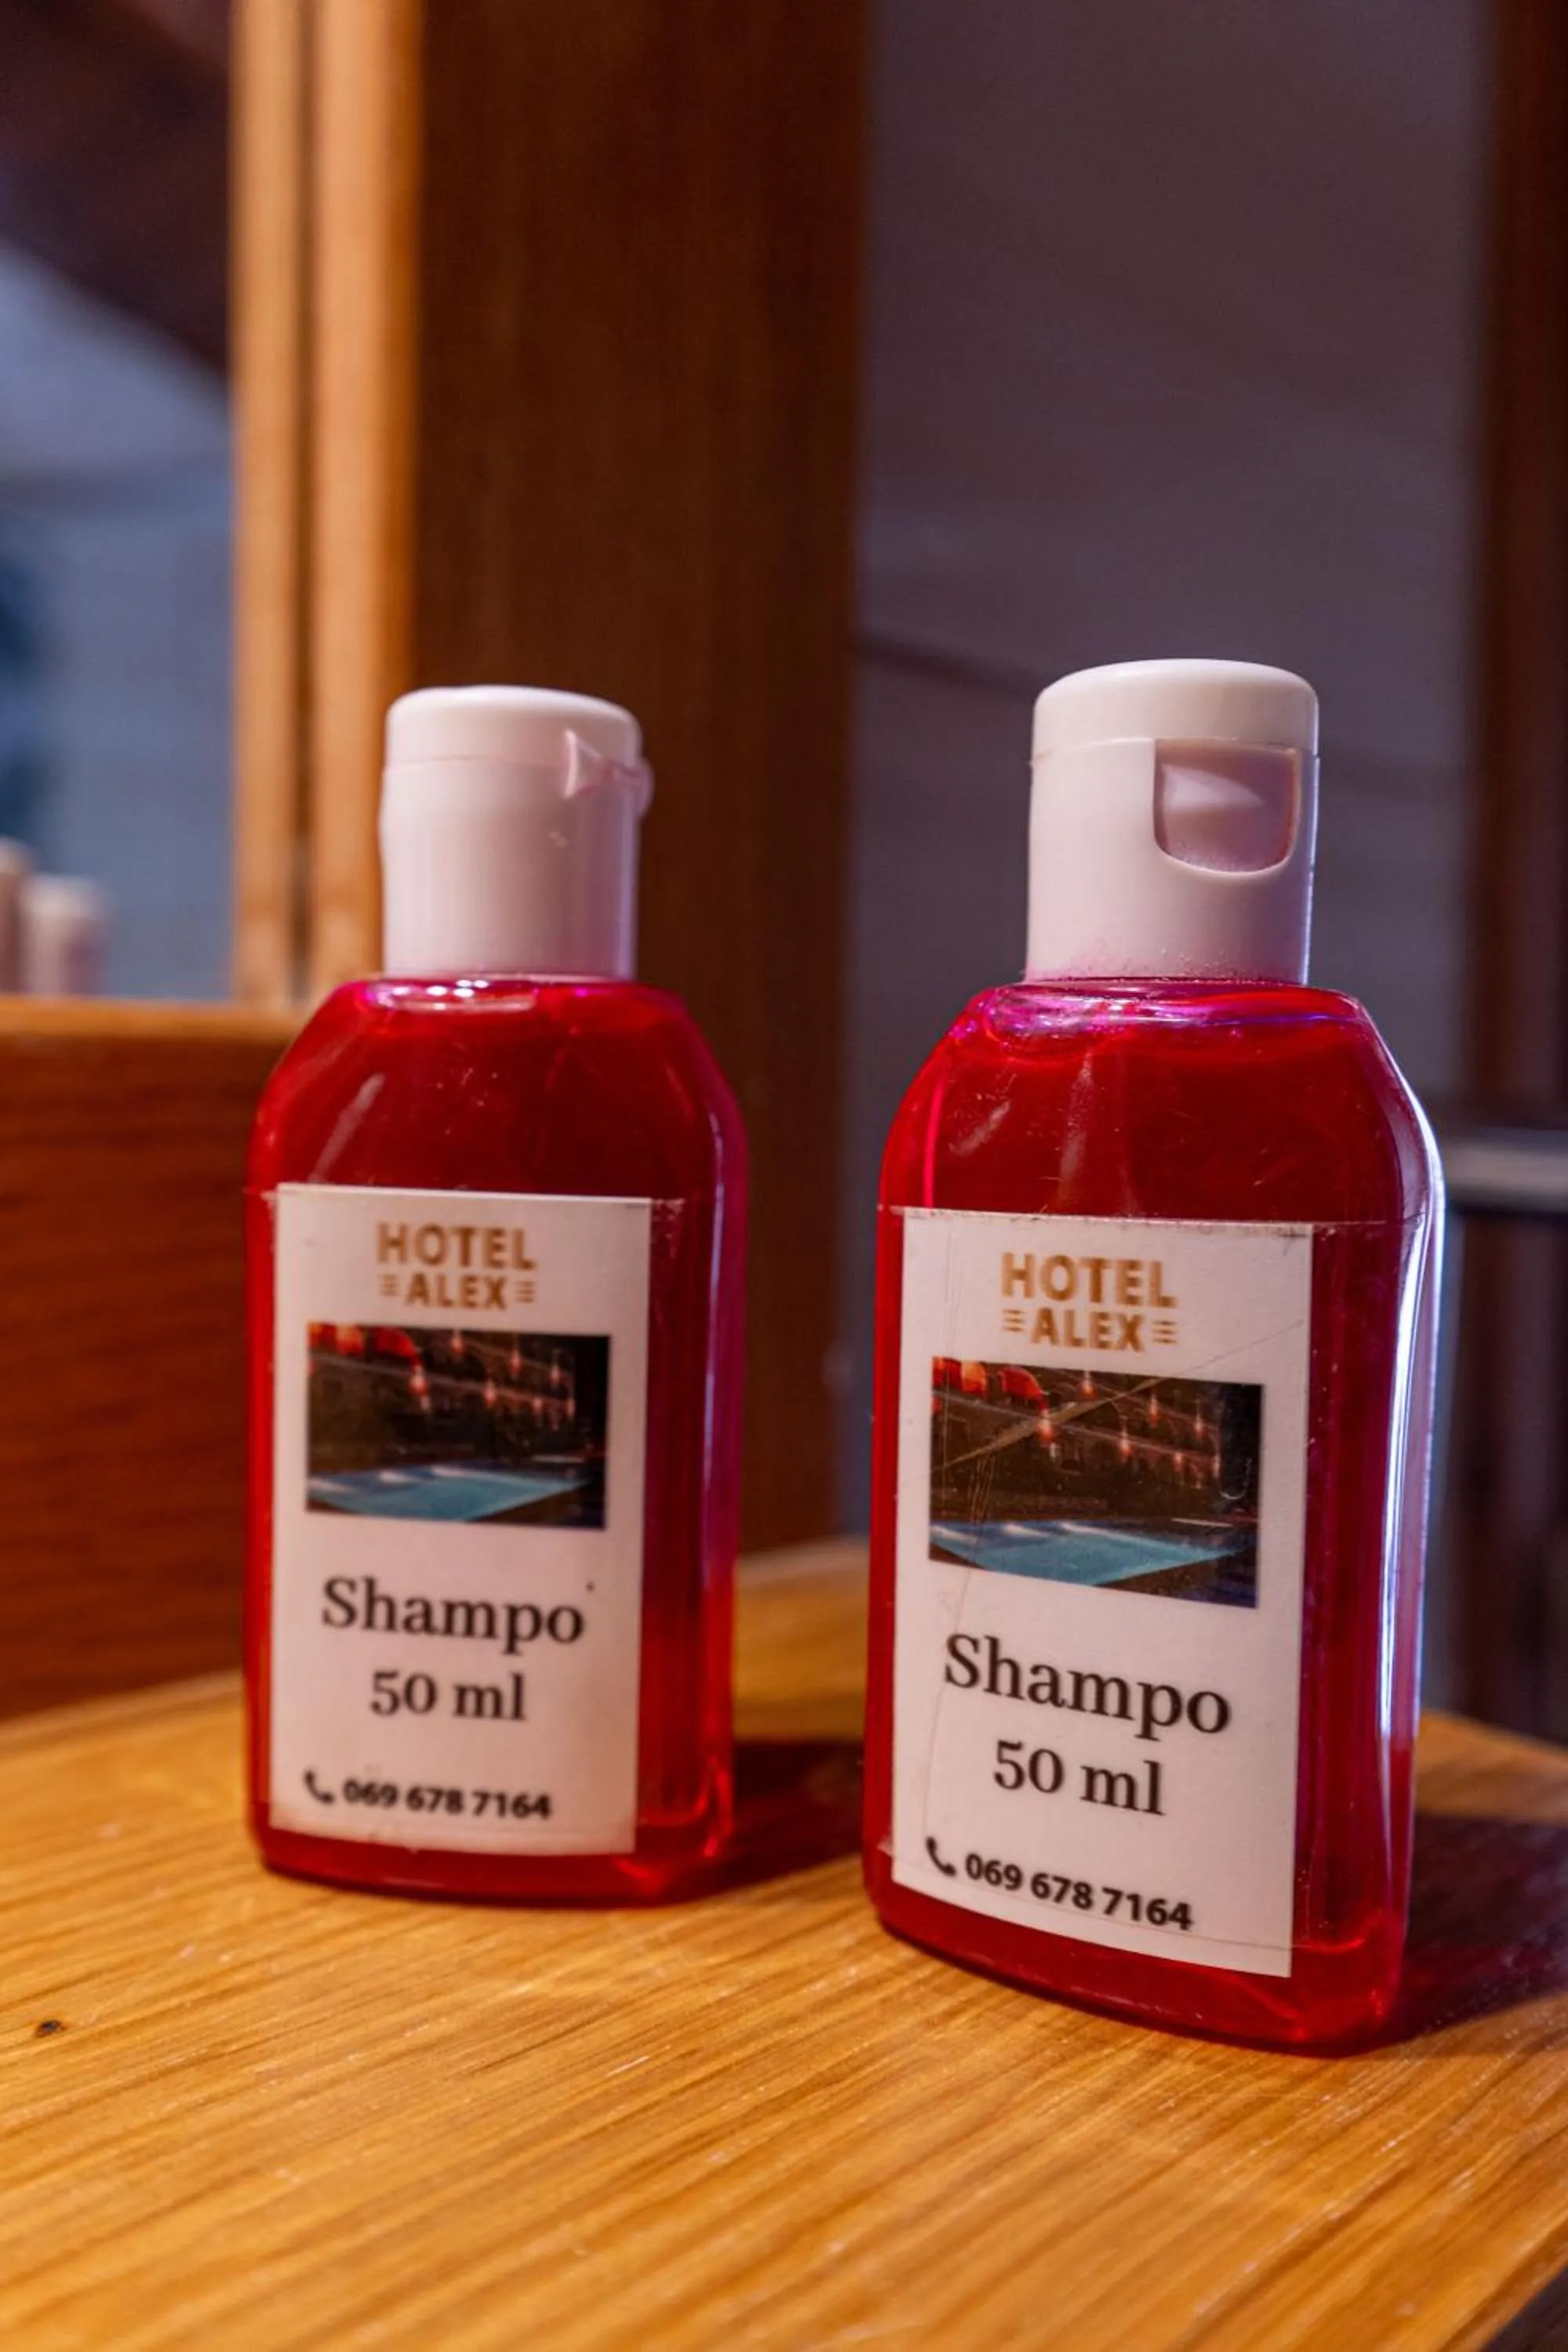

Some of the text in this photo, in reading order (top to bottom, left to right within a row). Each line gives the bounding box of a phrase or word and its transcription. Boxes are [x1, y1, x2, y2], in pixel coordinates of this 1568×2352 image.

[376, 1223, 536, 1271] HOTEL
[405, 1273, 509, 1310] ALEX
[1001, 1252, 1177, 1308] HOTEL
[1031, 1308, 1144, 1352] ALEX
[321, 1576, 586, 1654] Shampo
[371, 1670, 527, 1722] 50 ml
[945, 1633, 1230, 1739] Shampo
[343, 1778, 552, 1819] 069 678 7164
[993, 1740, 1165, 1816] 50 ml
[965, 1852, 1192, 1931] 069 678 7164
